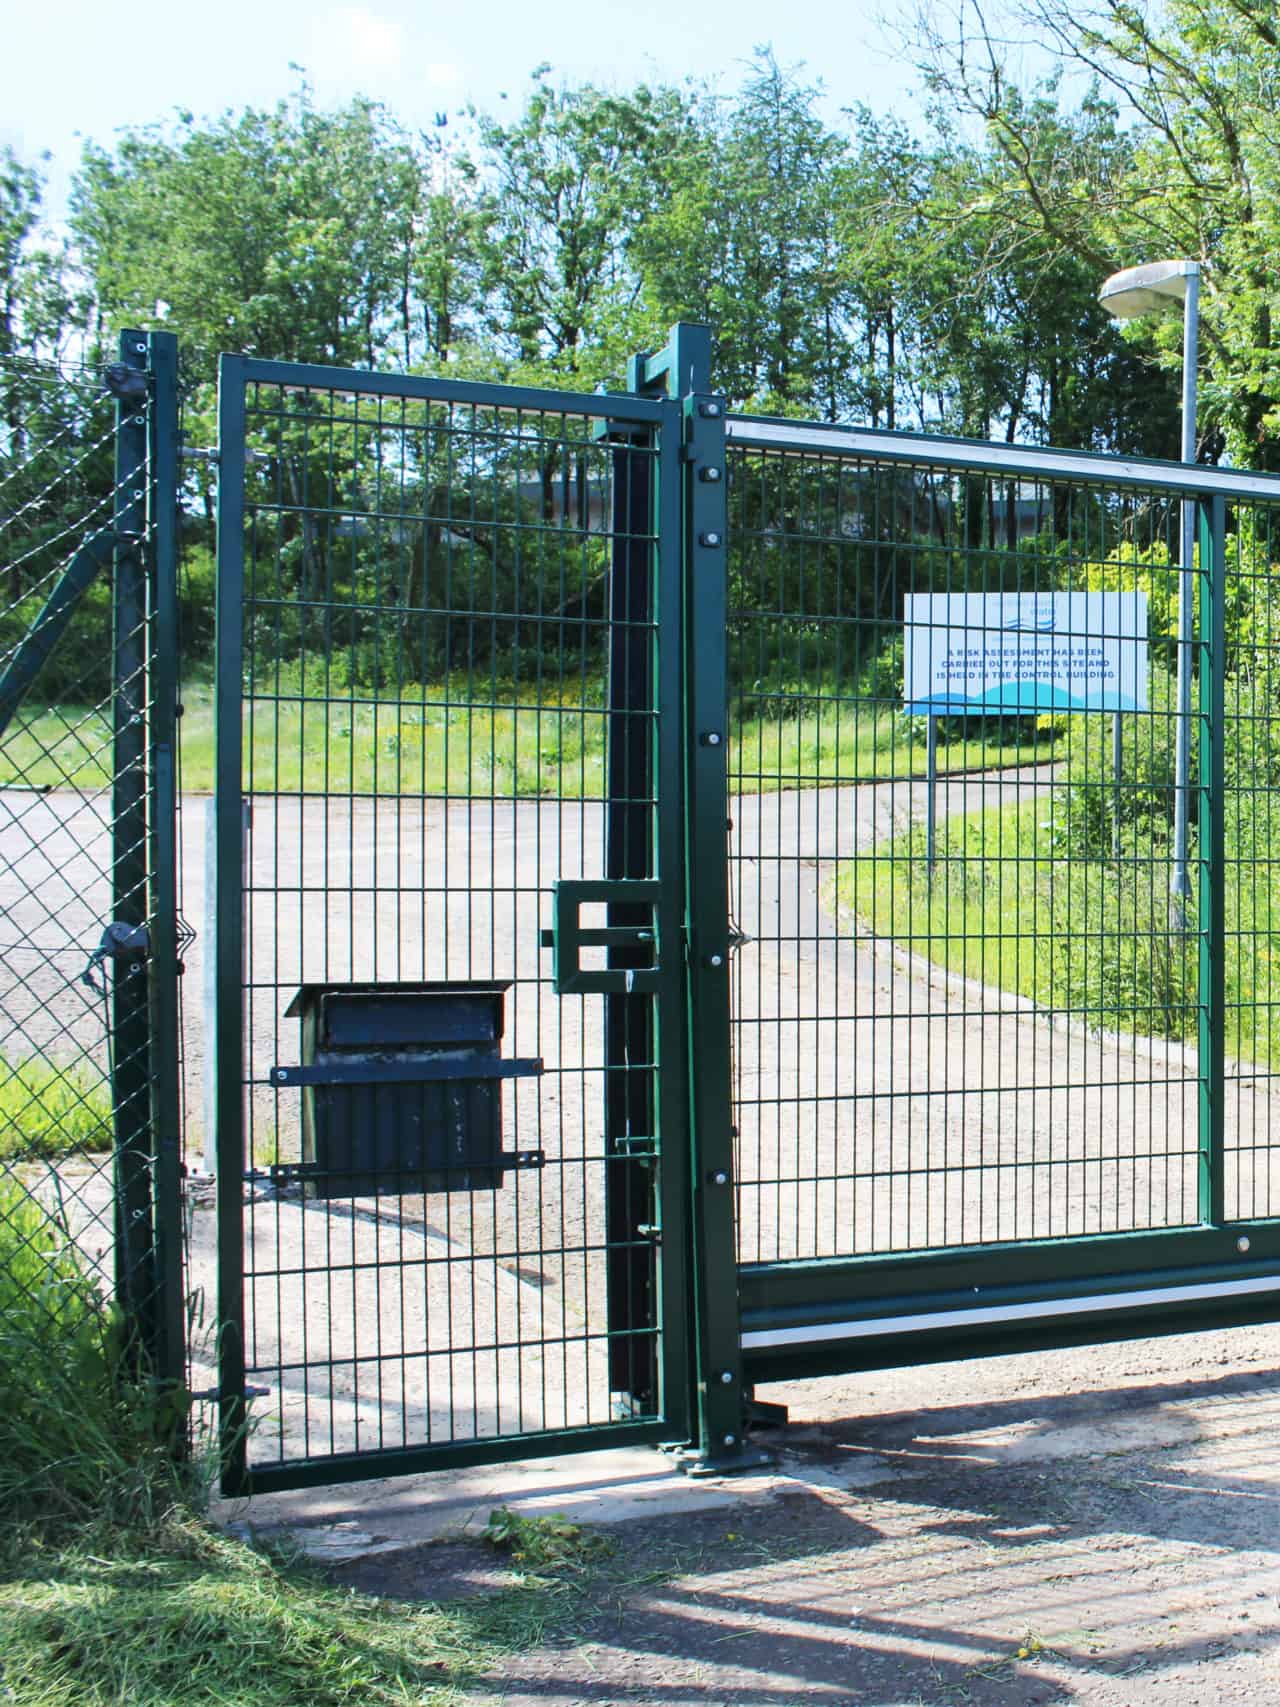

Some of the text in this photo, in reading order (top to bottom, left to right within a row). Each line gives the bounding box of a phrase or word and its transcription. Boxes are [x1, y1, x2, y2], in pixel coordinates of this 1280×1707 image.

[956, 649, 980, 657] RSK
[1036, 660, 1060, 668] THS
[1062, 660, 1085, 668] STE
[947, 671, 976, 679] HED
[1065, 671, 1115, 679] BUIDING
